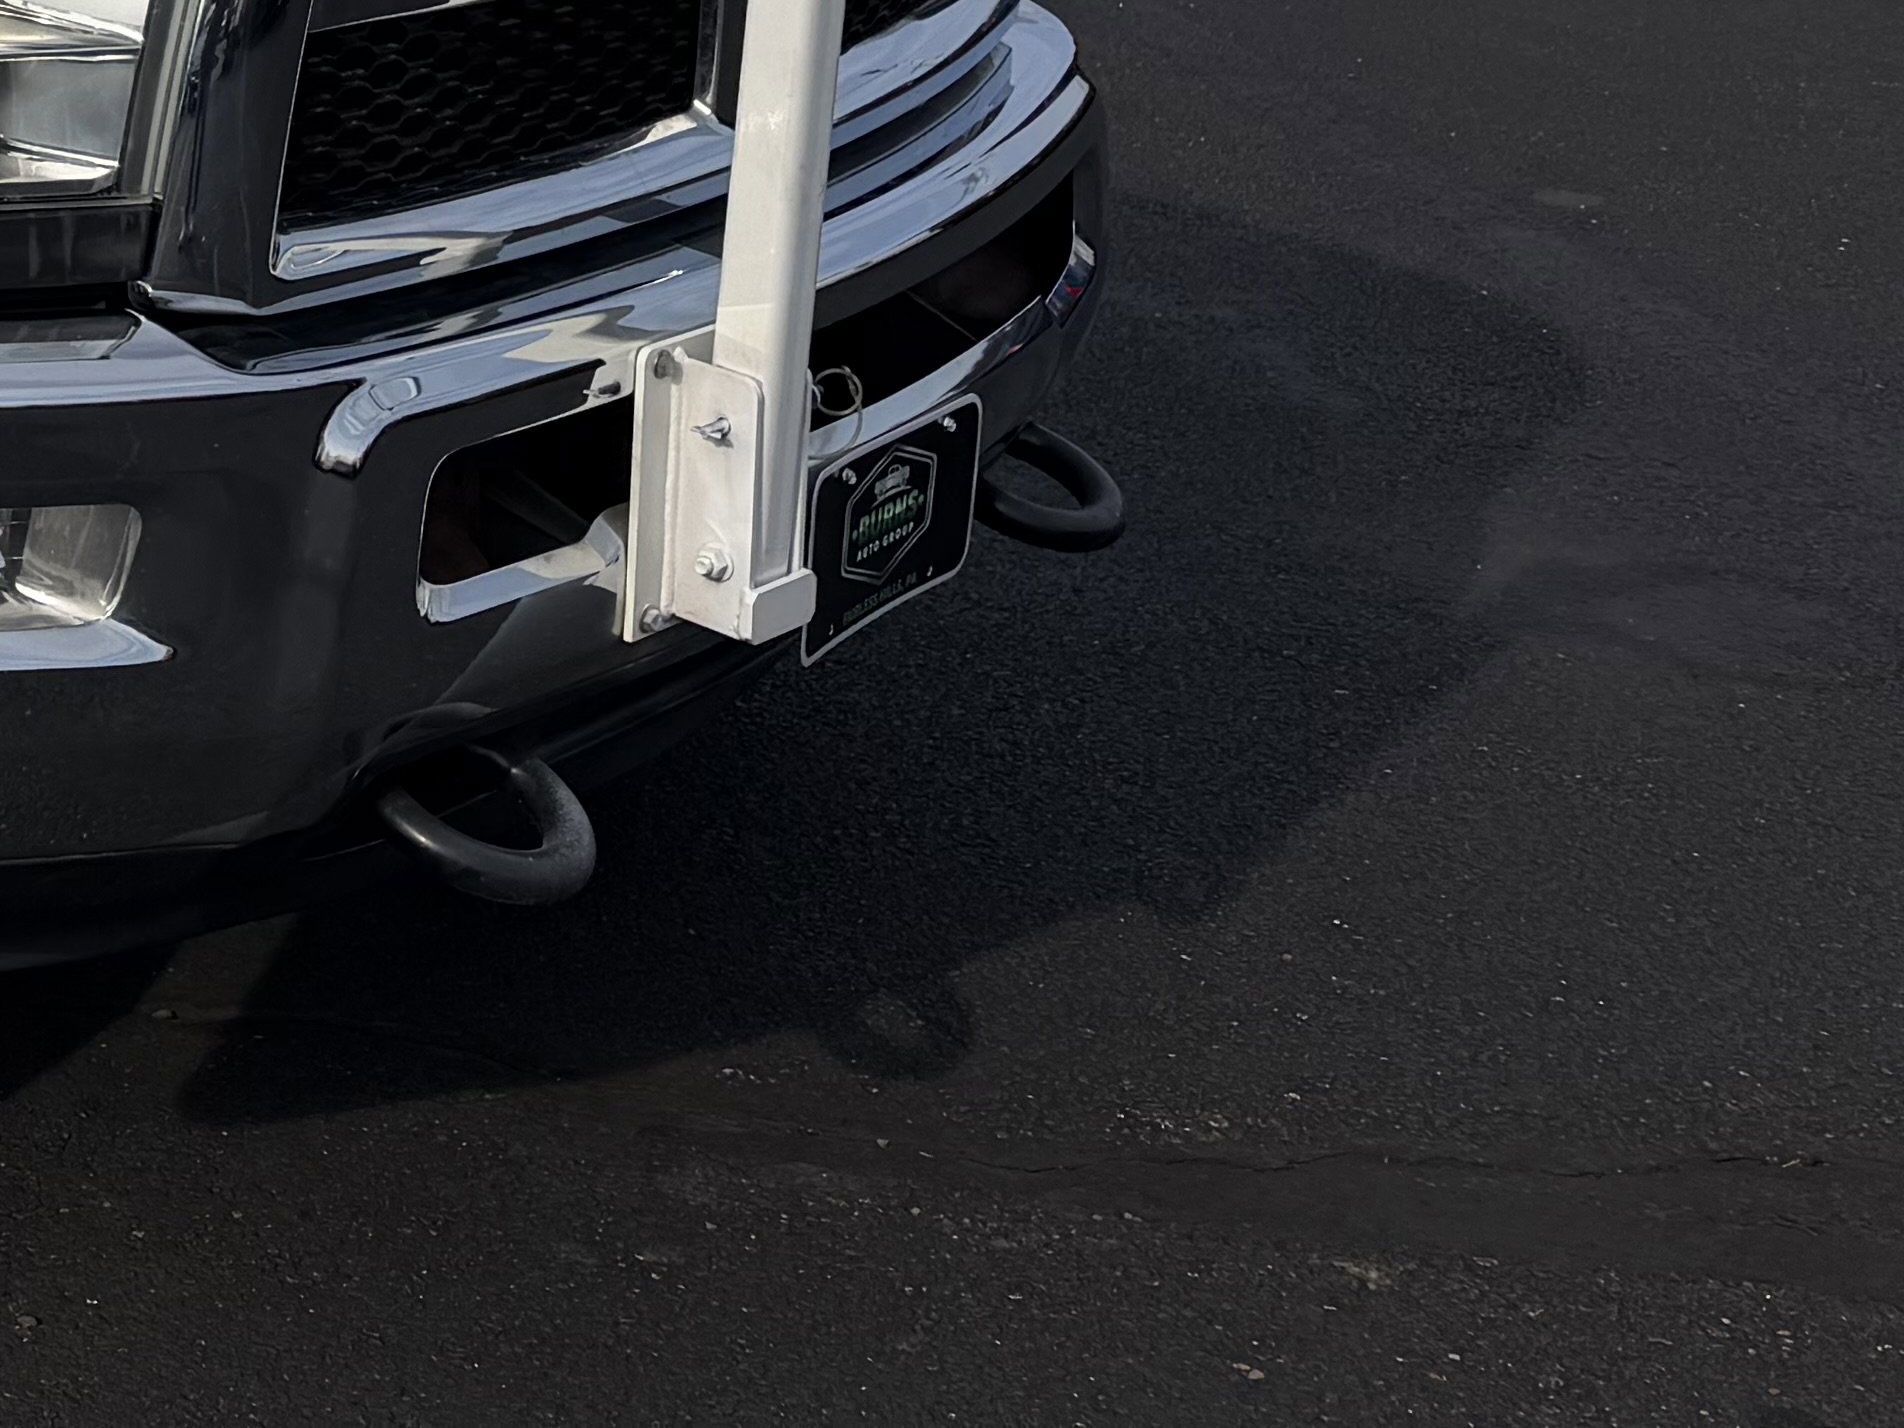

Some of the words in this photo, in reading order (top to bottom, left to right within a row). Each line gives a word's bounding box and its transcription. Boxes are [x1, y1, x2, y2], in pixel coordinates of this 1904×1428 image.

[858, 488, 920, 542] BURNS
[856, 540, 880, 563] AUTO
[882, 521, 914, 547] GROUP
